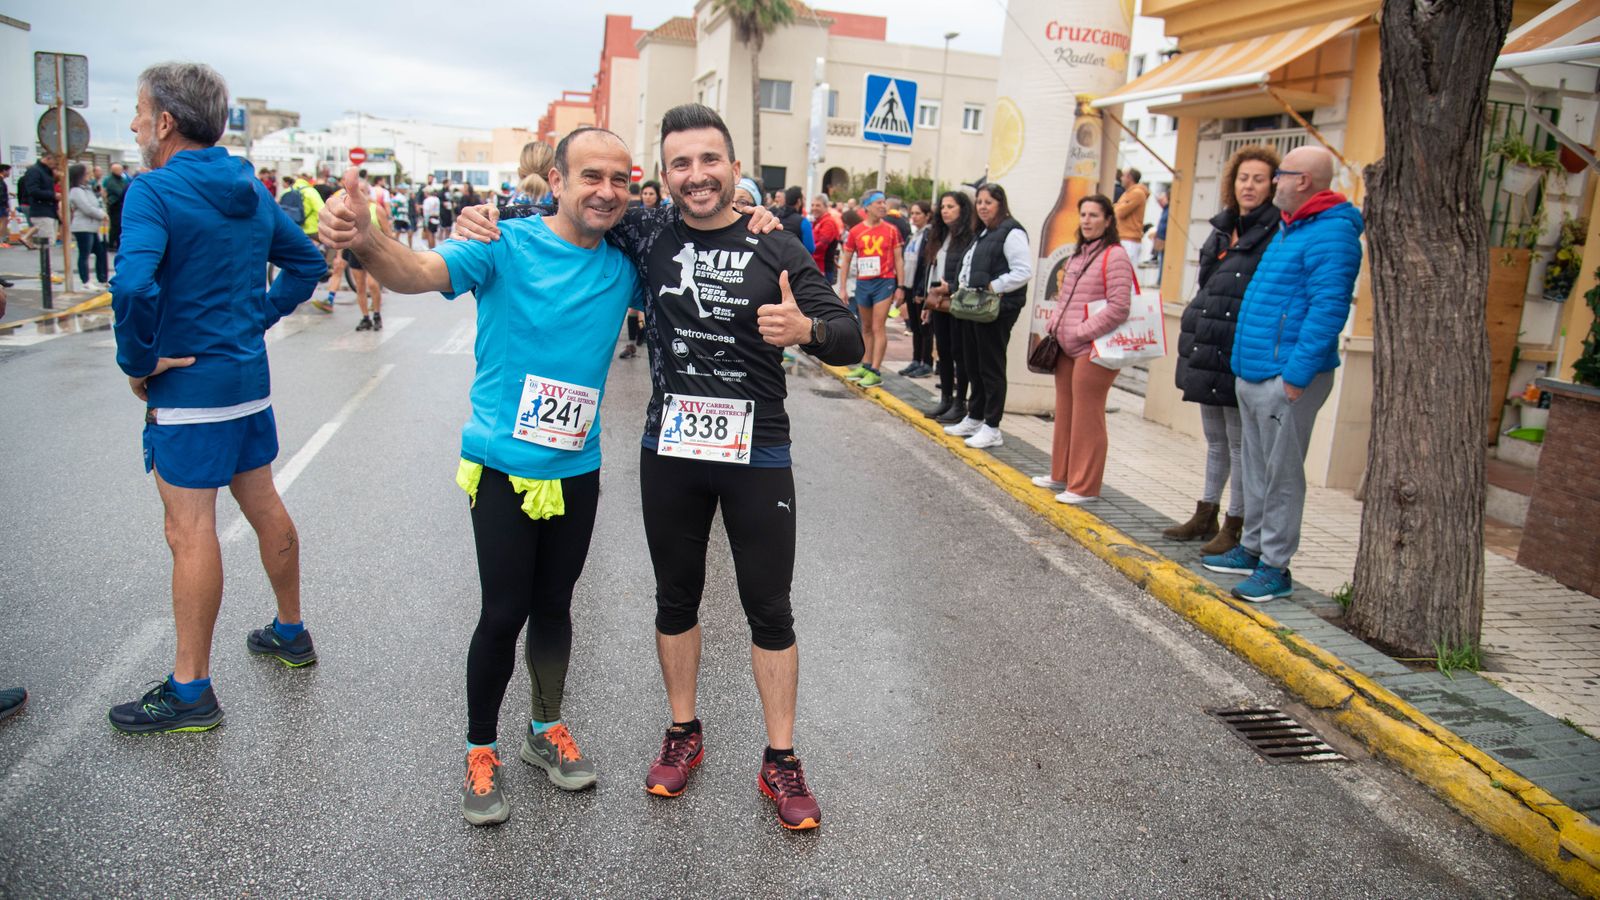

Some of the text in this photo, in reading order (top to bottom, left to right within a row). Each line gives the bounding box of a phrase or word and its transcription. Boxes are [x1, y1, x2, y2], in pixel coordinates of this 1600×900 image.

[1054, 47, 1105, 67] Radler
[698, 249, 754, 270] XIV
[695, 270, 744, 283] ESTRECHO
[700, 287, 727, 297] PEPE
[700, 293, 750, 306] SERRANO
[712, 306, 721, 316] 8
[538, 383, 568, 399] XIV
[540, 398, 582, 428] 241
[678, 400, 705, 413] XIV
[706, 402, 734, 410] CARRERA
[683, 413, 728, 440] 338
